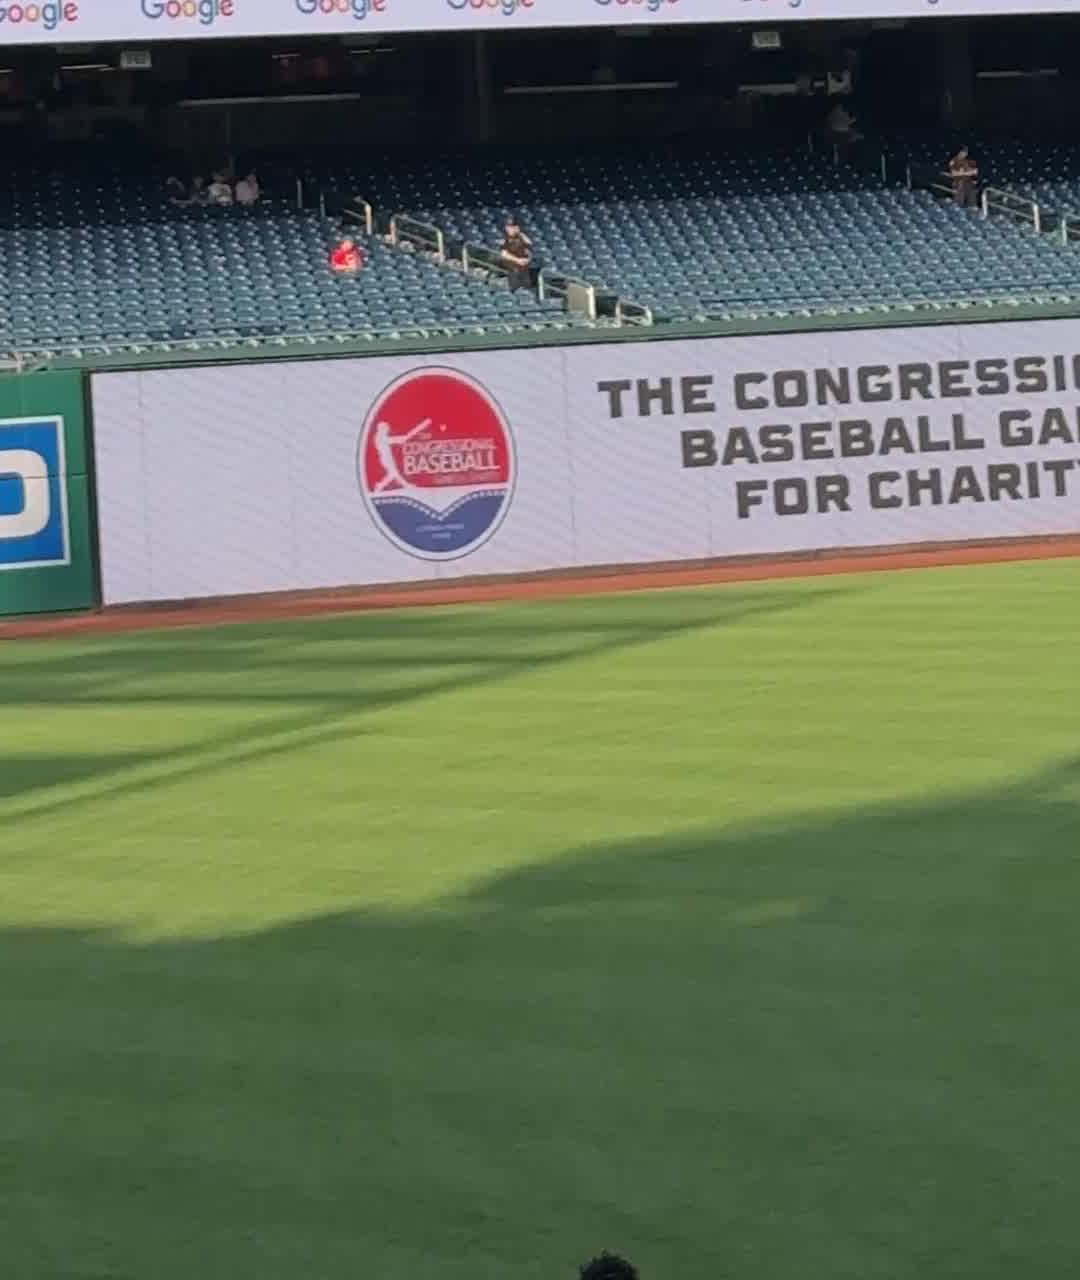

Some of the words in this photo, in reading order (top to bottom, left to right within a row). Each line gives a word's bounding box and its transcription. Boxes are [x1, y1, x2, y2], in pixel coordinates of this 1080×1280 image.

[597, 375, 716, 418] THE
[733, 353, 1080, 410] CONGRESSI
[403, 450, 500, 475] BASEBALL
[680, 413, 985, 468] BASEBALL
[735, 474, 851, 519] FOR
[867, 459, 1080, 510] CHARIT
